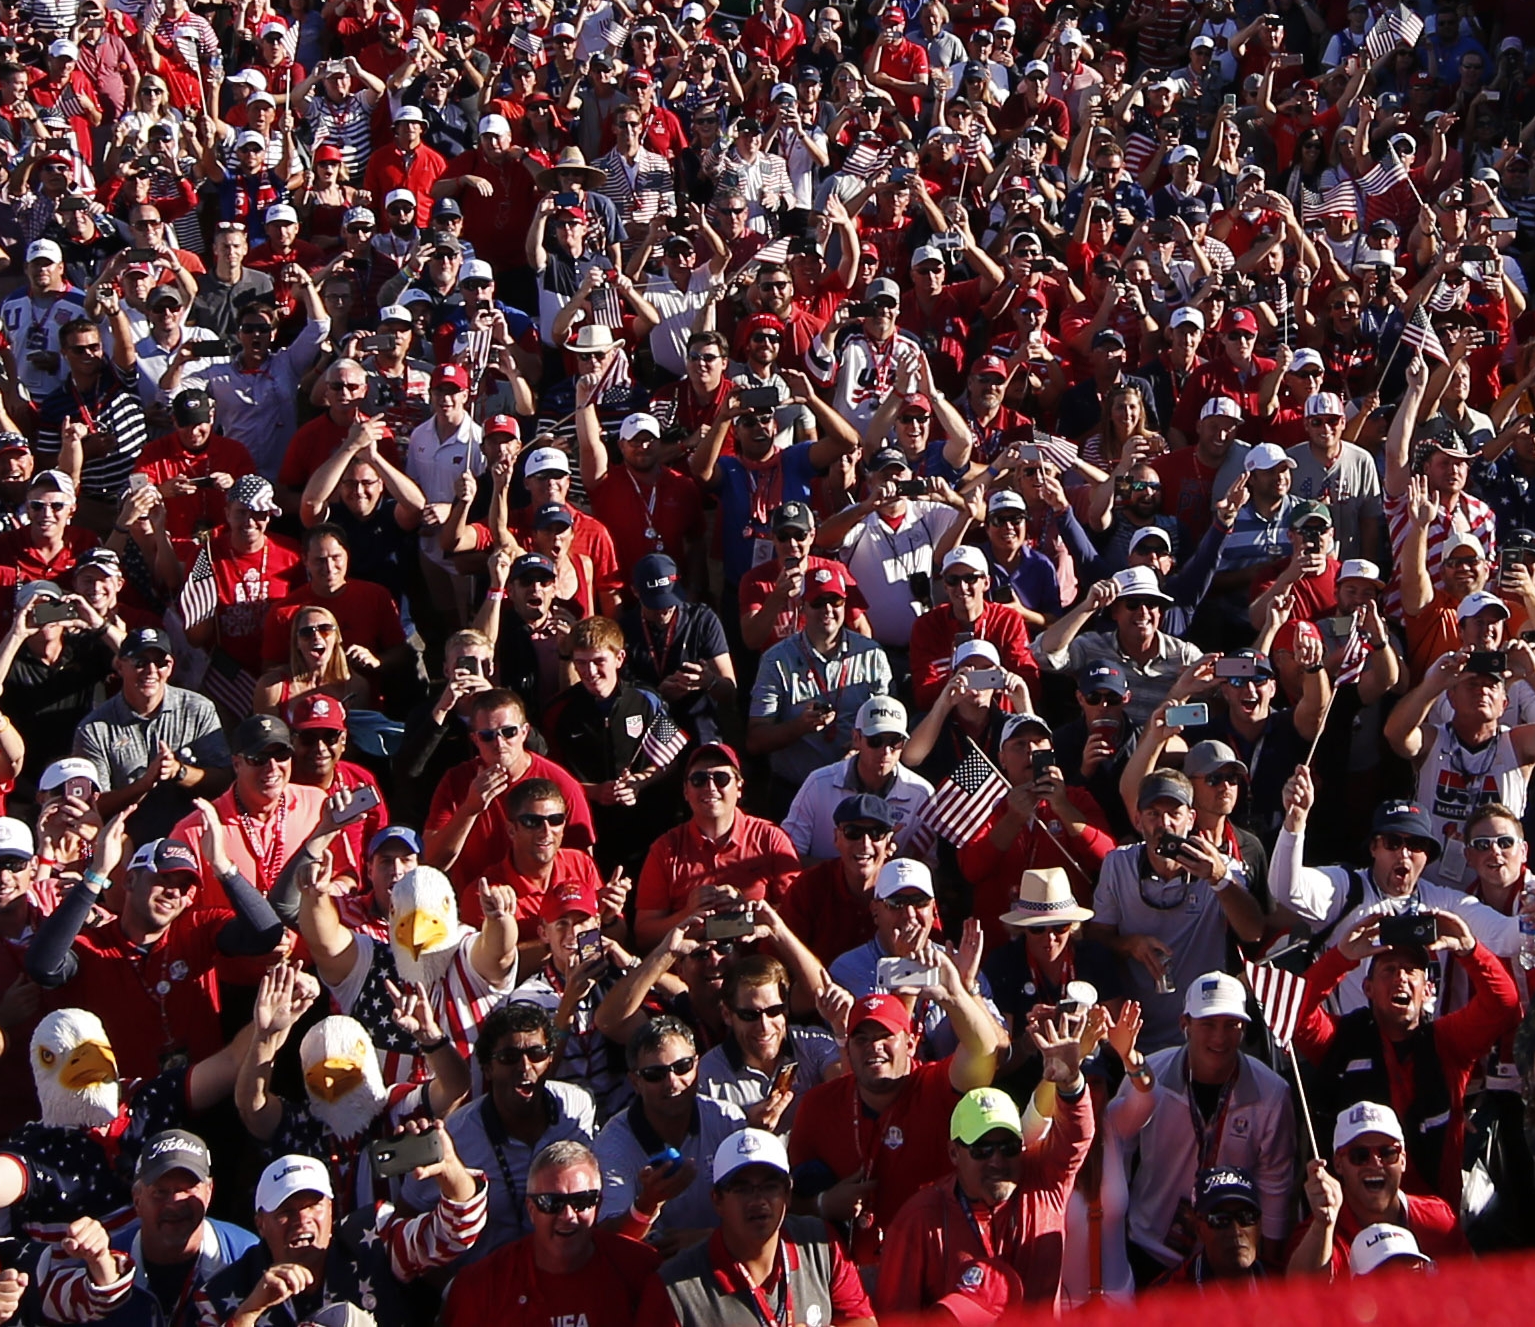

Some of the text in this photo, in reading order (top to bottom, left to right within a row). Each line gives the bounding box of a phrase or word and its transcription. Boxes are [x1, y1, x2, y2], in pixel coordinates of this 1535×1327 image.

[521, 556, 549, 565] USA
[646, 574, 680, 589] USA
[1089, 667, 1119, 676] USA
[869, 708, 902, 719] PING
[1386, 805, 1421, 815] USA
[148, 1136, 204, 1160] Titleist
[273, 1165, 315, 1182] USA
[1203, 1172, 1252, 1194] Titleist
[1366, 1232, 1404, 1248] USA
